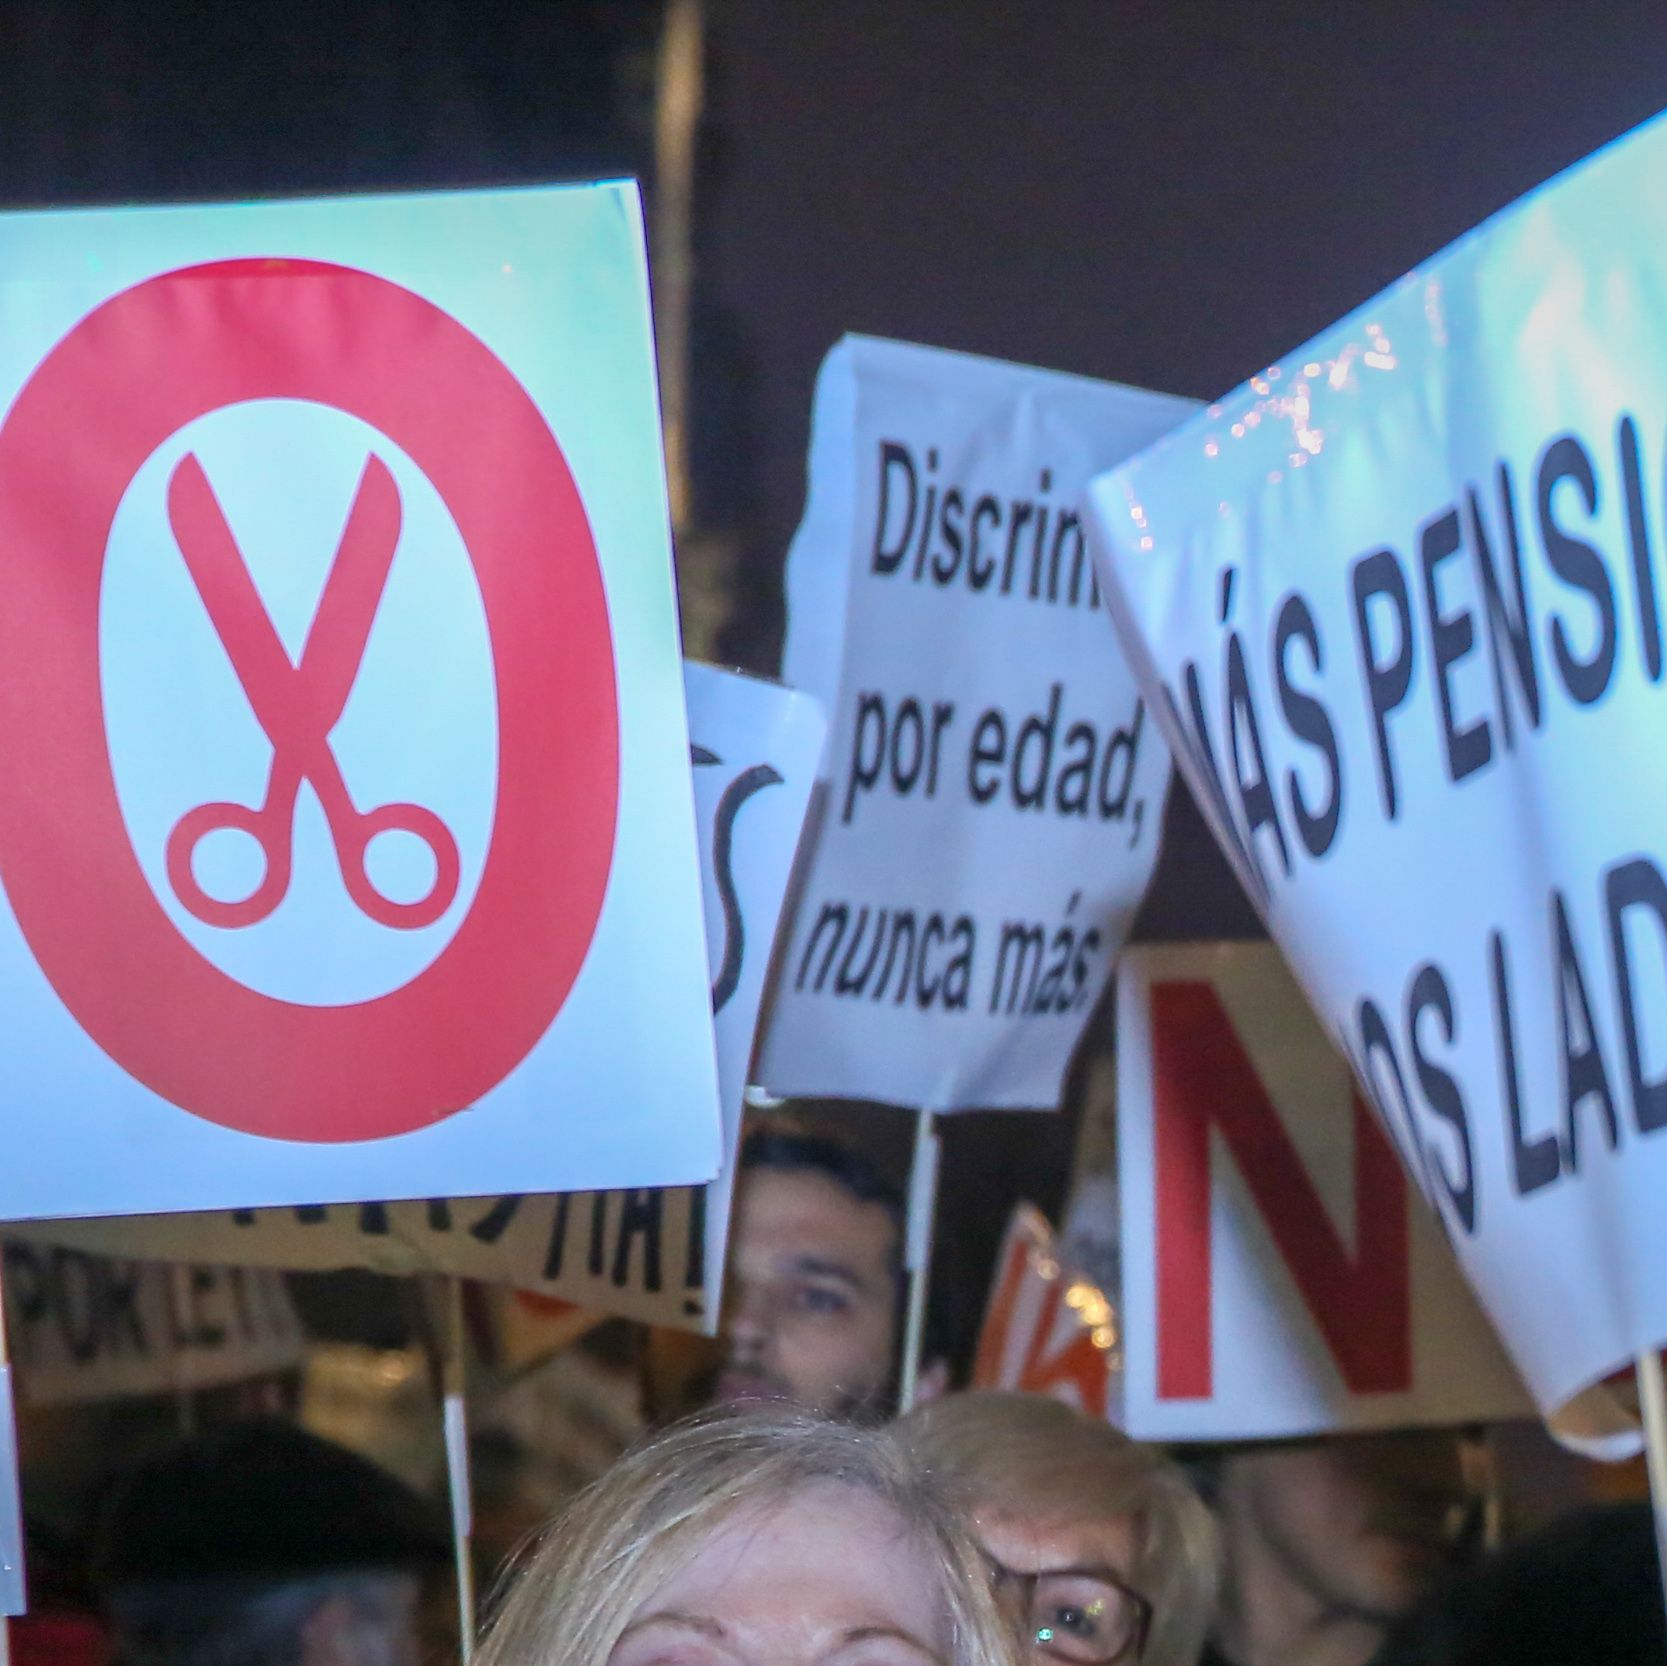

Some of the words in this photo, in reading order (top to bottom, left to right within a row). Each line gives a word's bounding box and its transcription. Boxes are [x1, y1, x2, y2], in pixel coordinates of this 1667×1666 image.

[871, 441, 1101, 610] Discrim
[844, 692, 954, 824] por
[969, 683, 1147, 850] edad,
[795, 898, 976, 1012] nunca
[1335, 964, 1476, 1238] OS
